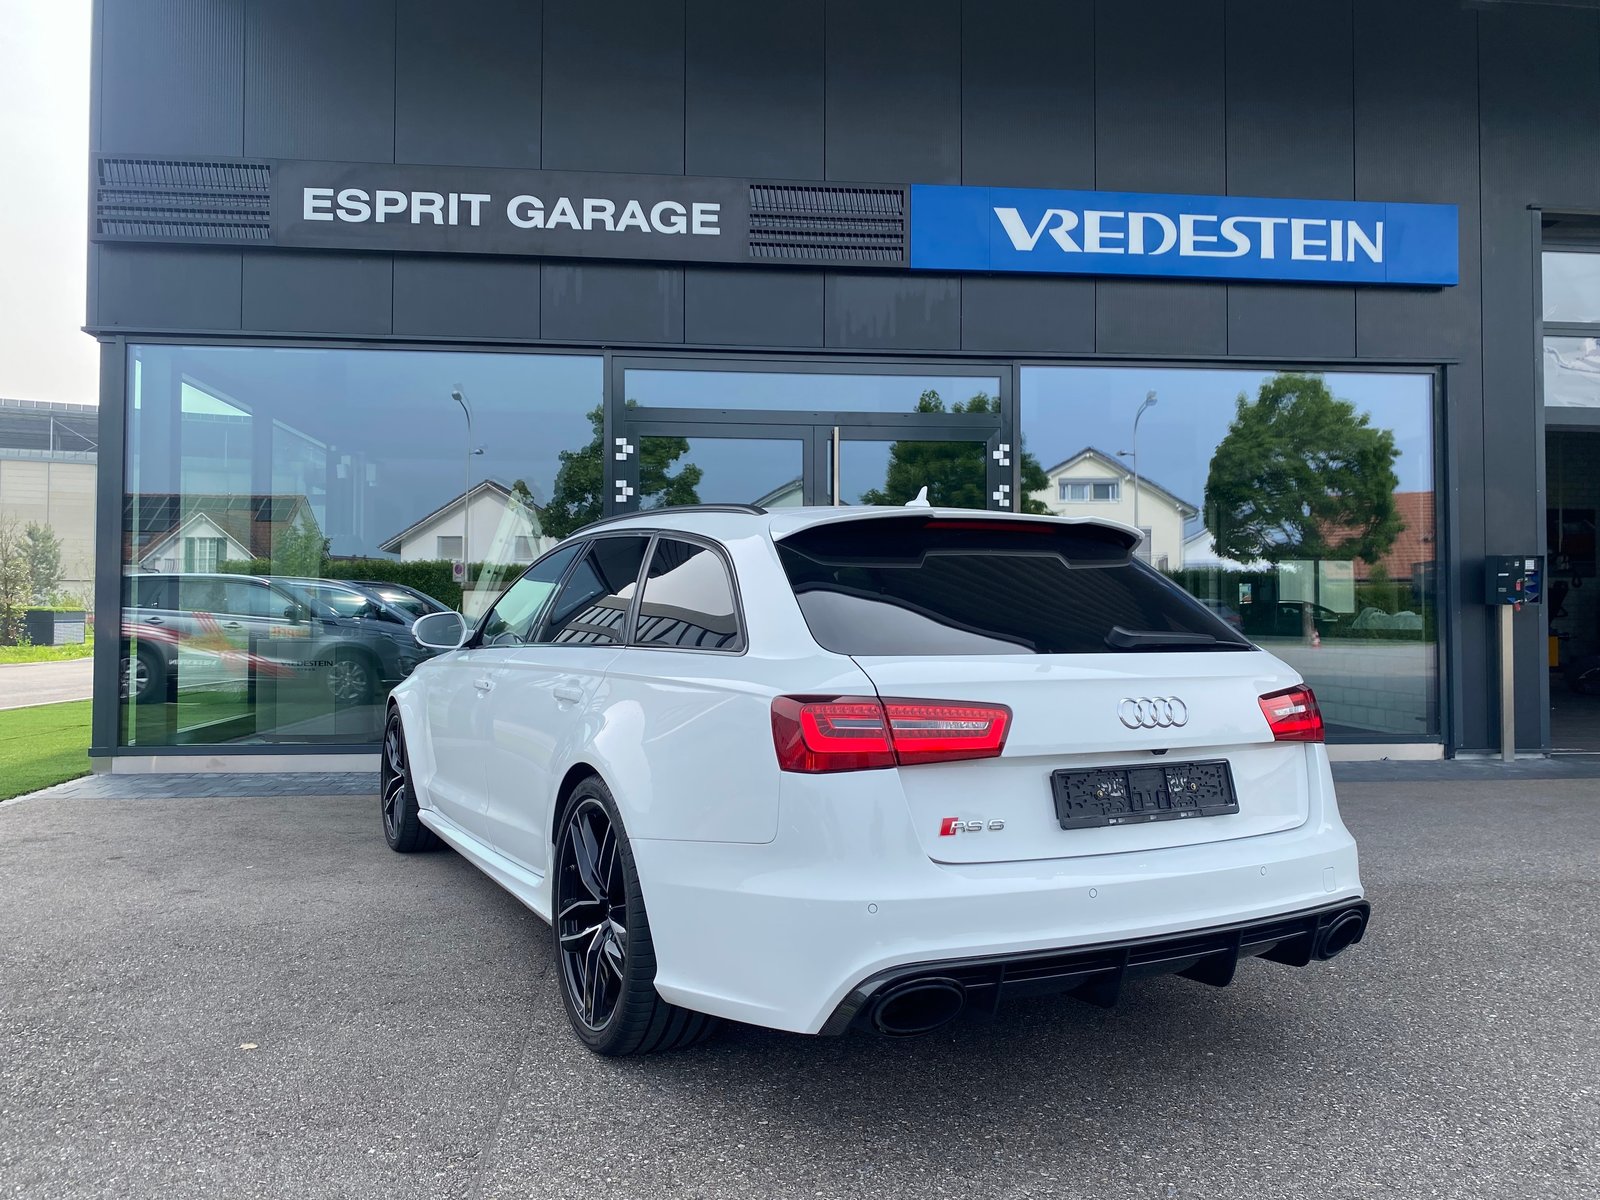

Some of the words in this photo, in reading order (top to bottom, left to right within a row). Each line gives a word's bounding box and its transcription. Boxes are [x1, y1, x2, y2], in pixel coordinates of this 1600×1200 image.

[303, 187, 491, 226] ESPRIT
[506, 195, 721, 235] GARAGE
[993, 207, 1384, 263] VREDESTEIN
[949, 820, 983, 834] RS
